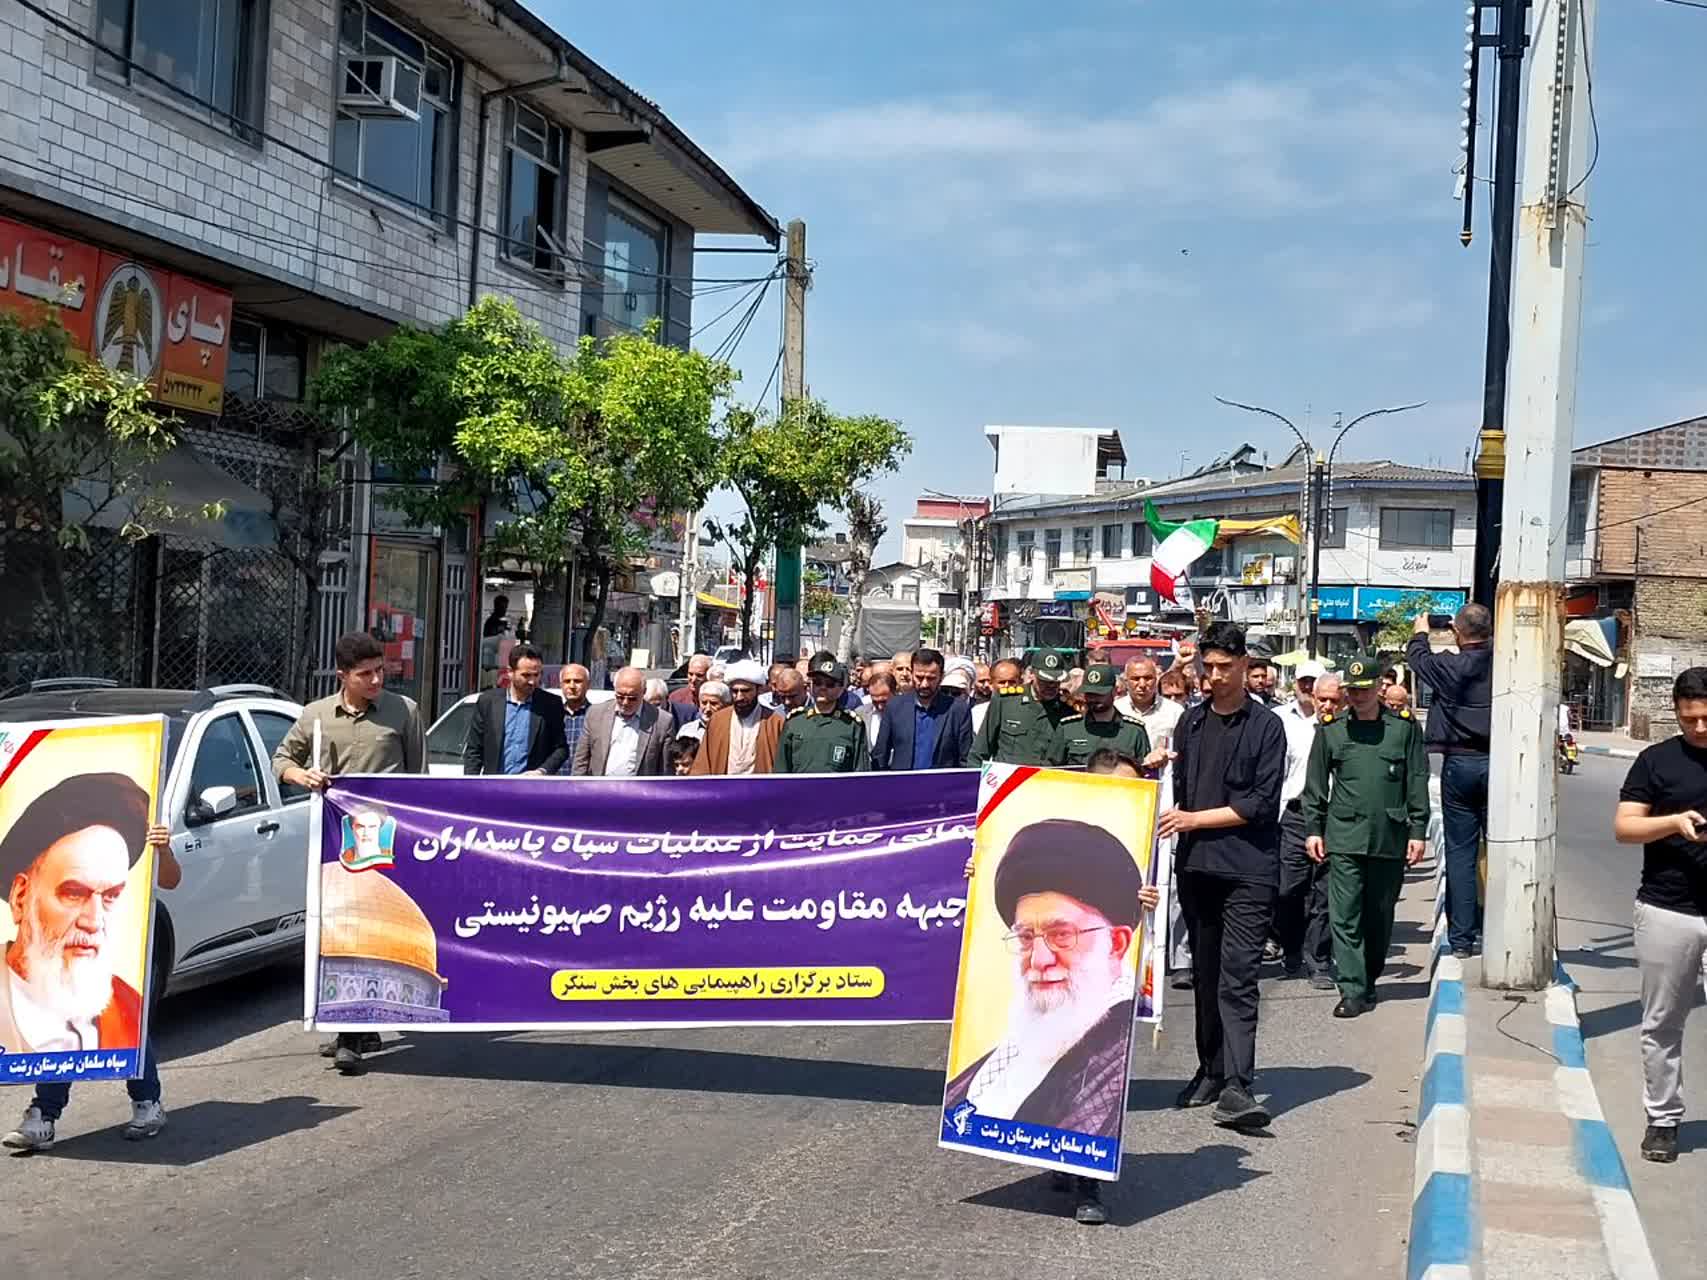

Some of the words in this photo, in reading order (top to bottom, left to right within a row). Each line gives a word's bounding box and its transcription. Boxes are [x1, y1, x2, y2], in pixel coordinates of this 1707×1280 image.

[168, 294, 225, 367] چای
[412, 826, 545, 861] پاسداران
[551, 832, 620, 860] سپاه
[626, 829, 742, 858] عملیات
[742, 828, 775, 857] از
[781, 829, 883, 851] حمایت
[454, 894, 613, 938] صهیونیستی
[619, 894, 681, 933] رژیم
[689, 889, 754, 929] علیه
[762, 889, 888, 930] مقاومت
[896, 892, 967, 931] جبهه
[601, 974, 639, 995] بخش
[643, 975, 679, 995] های
[683, 973, 765, 995] راهپیمایی
[769, 972, 831, 994] برگزاری
[836, 973, 873, 989] ستاد
[9, 1058, 32, 1077] رشت
[34, 1056, 75, 1076] شهرستان
[75, 1054, 105, 1073] سلمان
[106, 1053, 127, 1072] سپاه
[980, 1123, 1005, 1144] رشت
[1007, 1127, 1050, 1149] شهرستان
[1051, 1134, 1083, 1154] سلمان
[1084, 1140, 1108, 1162] سپاه
